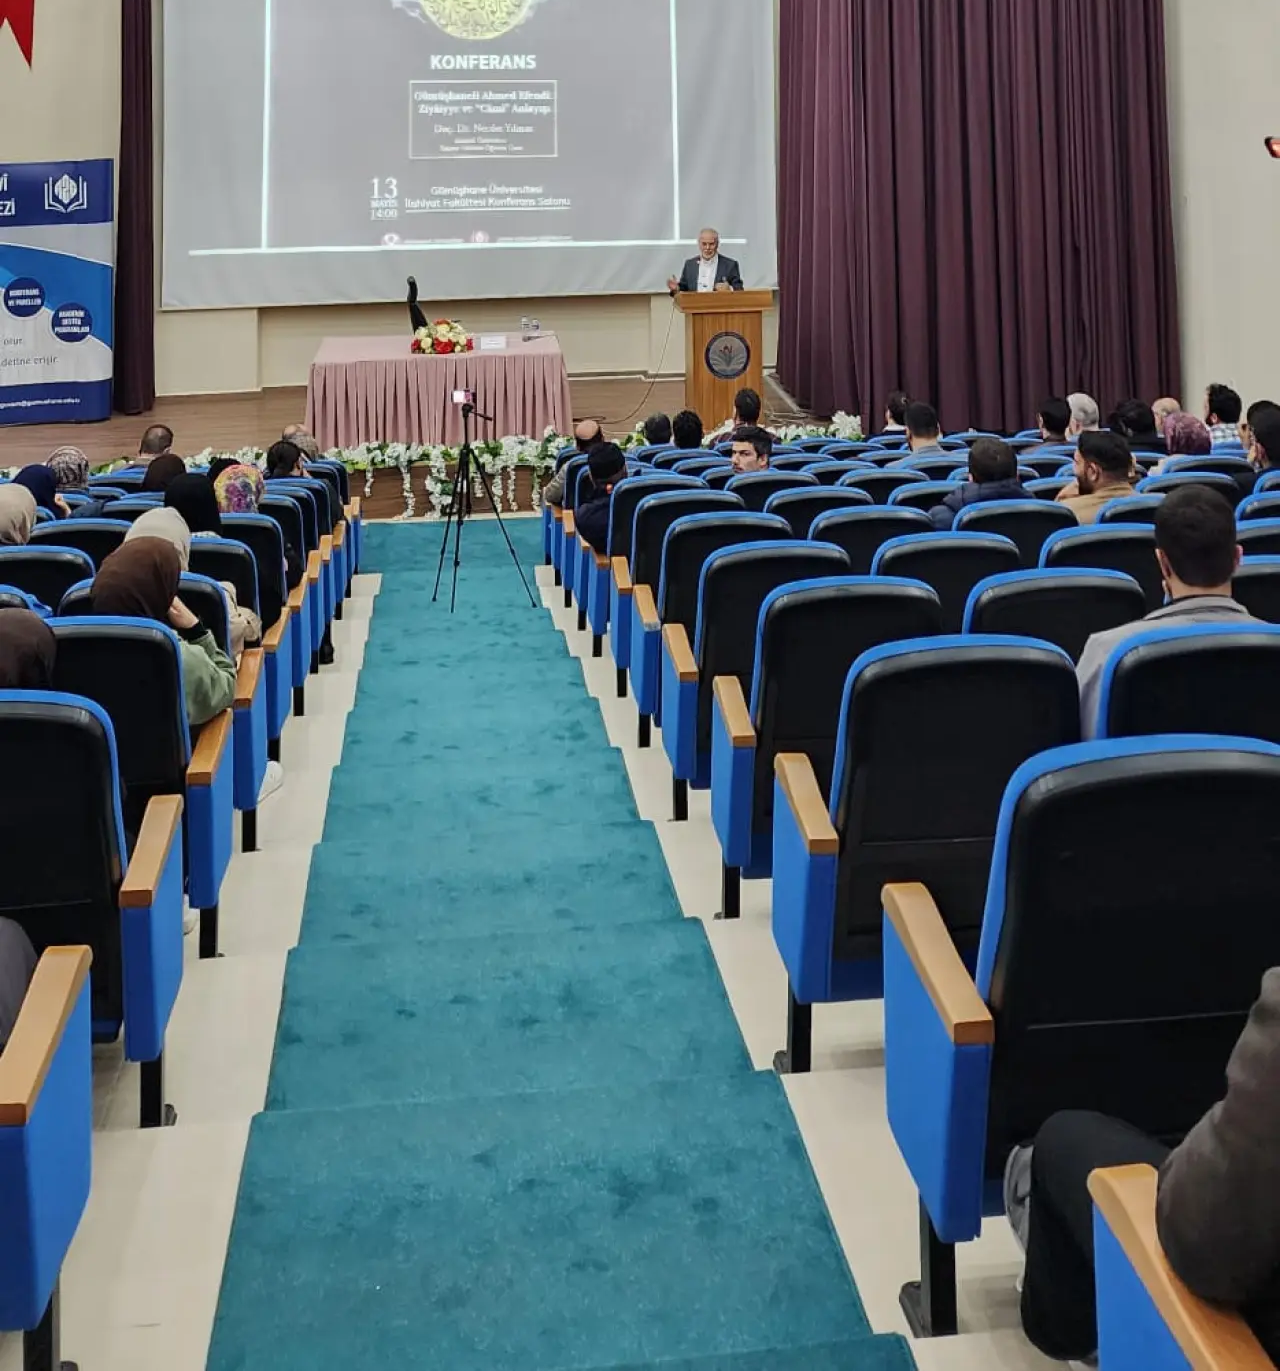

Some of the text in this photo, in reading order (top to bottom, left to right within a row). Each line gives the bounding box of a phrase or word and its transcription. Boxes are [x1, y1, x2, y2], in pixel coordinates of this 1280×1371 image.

[430, 54, 537, 70] KONFERANS
[371, 177, 398, 199] 13
[370, 208, 398, 219] 14:00
